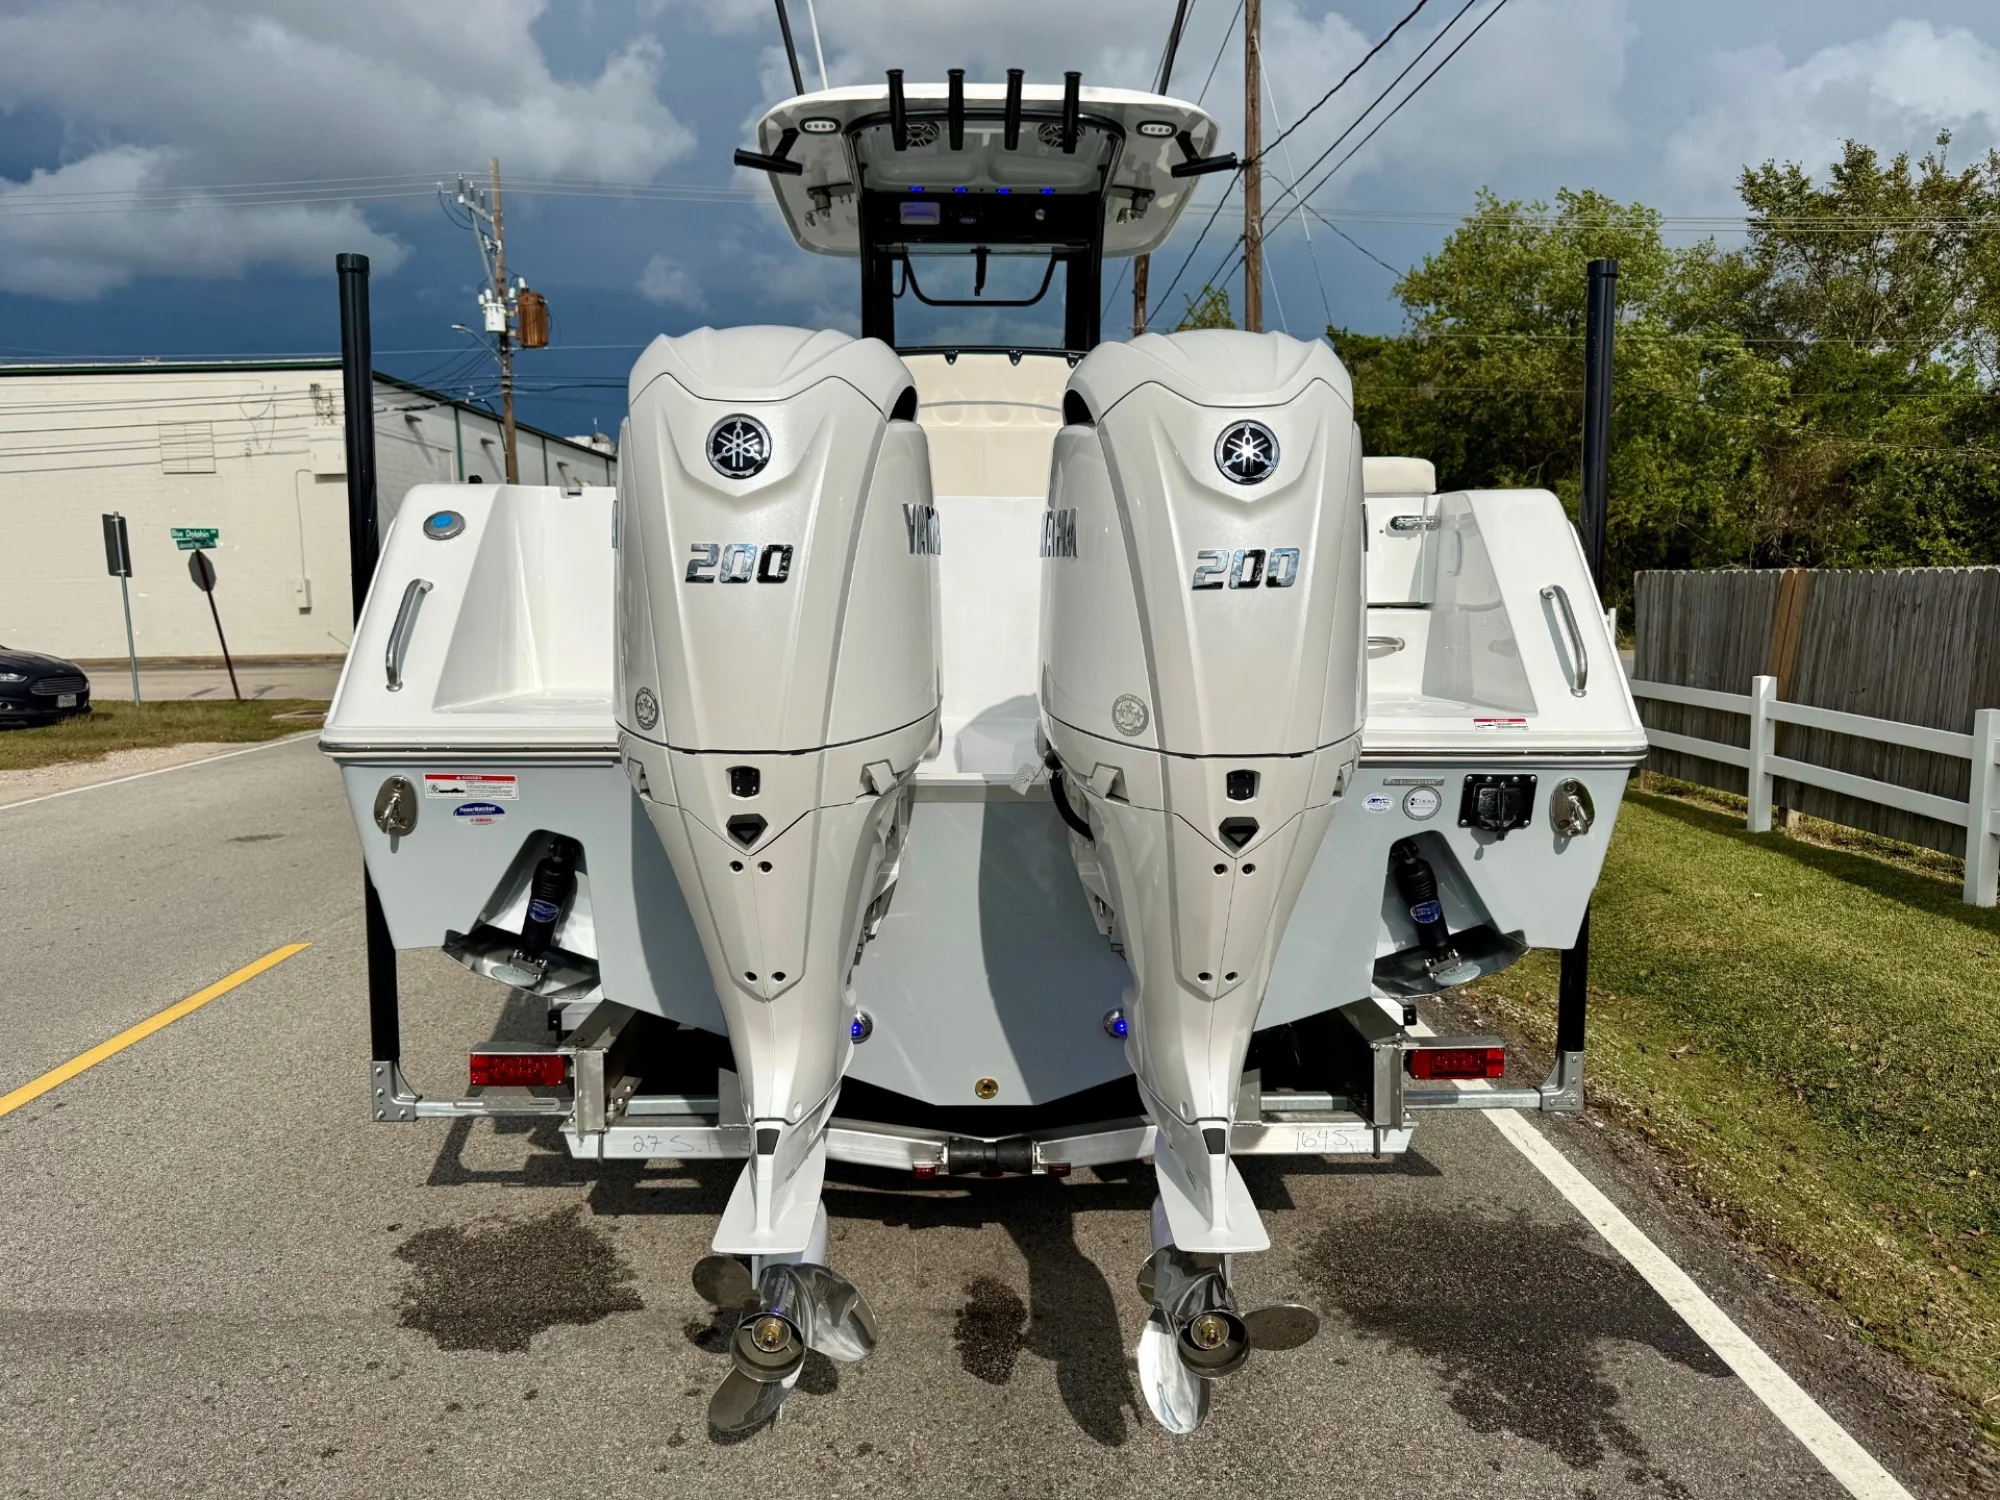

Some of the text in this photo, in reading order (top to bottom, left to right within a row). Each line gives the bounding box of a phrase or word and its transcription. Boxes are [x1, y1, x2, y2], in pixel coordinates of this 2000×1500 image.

[171, 529, 184, 537] Blue
[186, 529, 210, 538] Dolphin
[685, 543, 795, 584] 200
[1191, 547, 1301, 590] 200
[632, 1134, 664, 1153] 27
